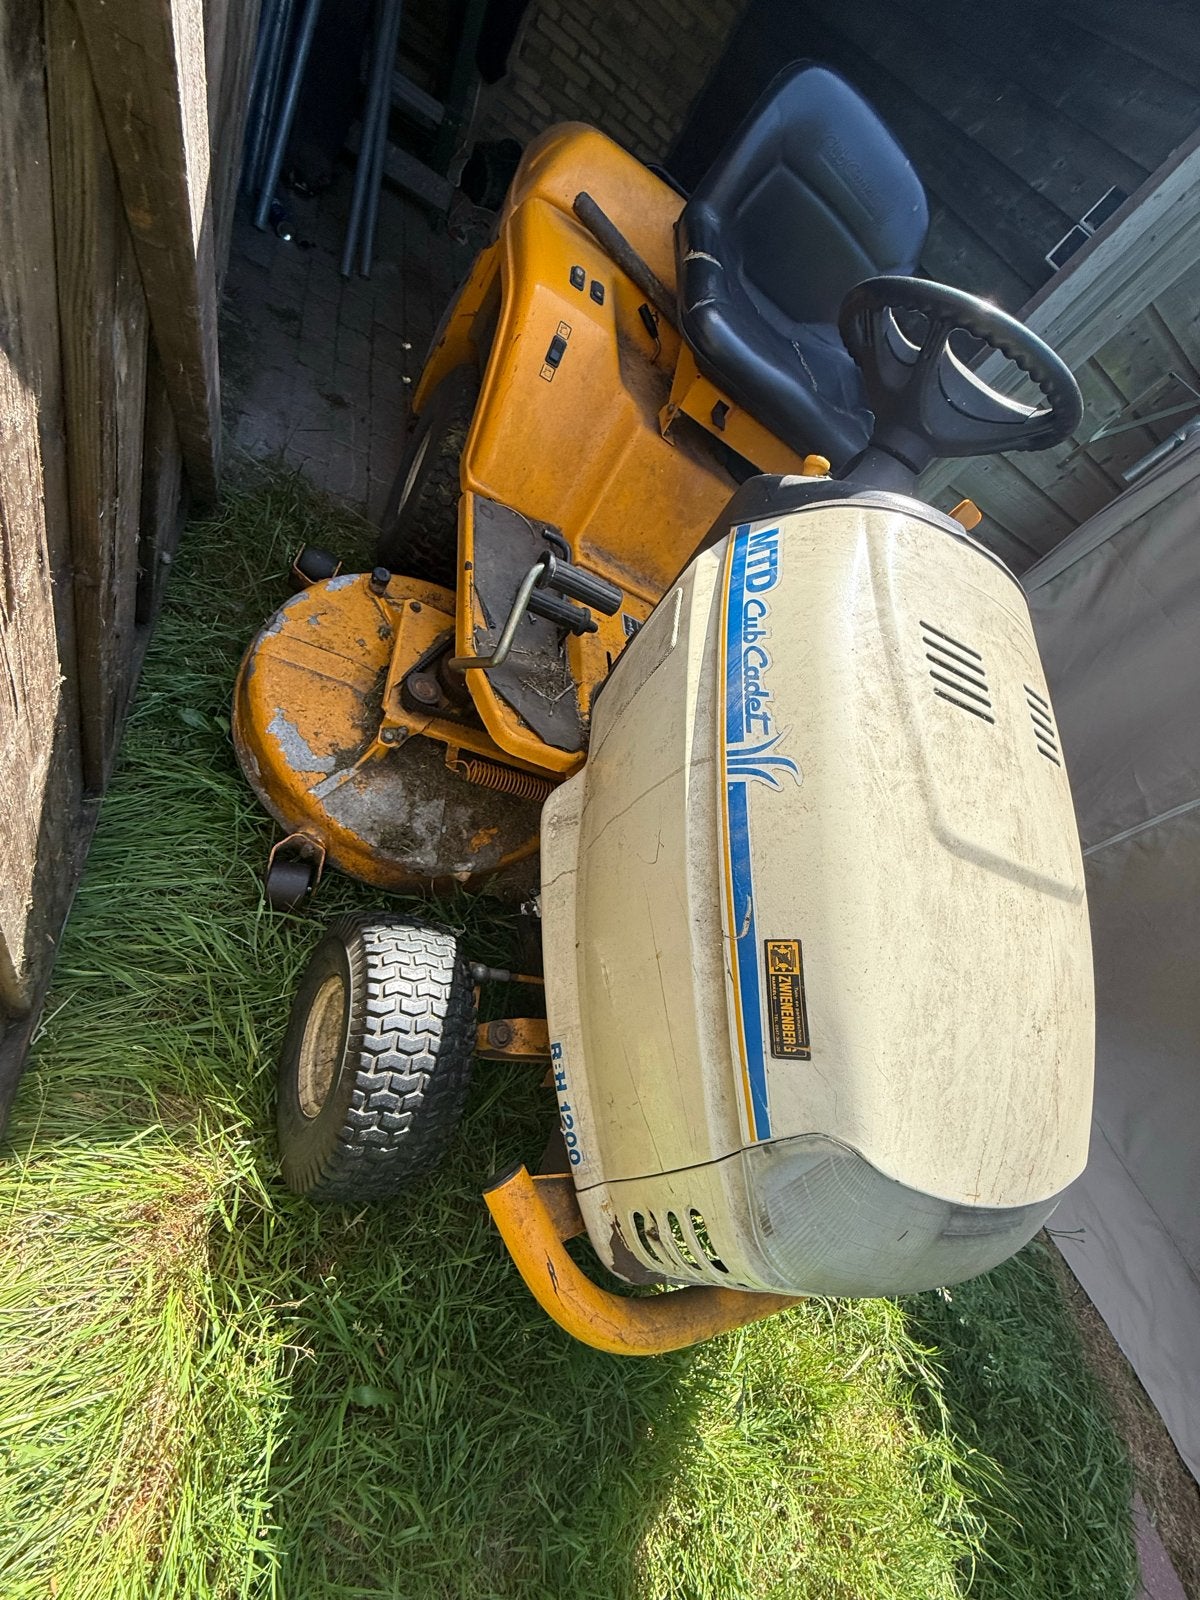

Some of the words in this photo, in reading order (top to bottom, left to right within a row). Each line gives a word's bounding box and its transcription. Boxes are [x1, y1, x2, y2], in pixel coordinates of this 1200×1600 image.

[746, 528, 780, 593] MTD
[743, 599, 767, 643] Cub
[743, 645, 771, 735] Cadet
[779, 975, 797, 1053] ZWIENENBERG
[560, 1101, 581, 1165] 1200
